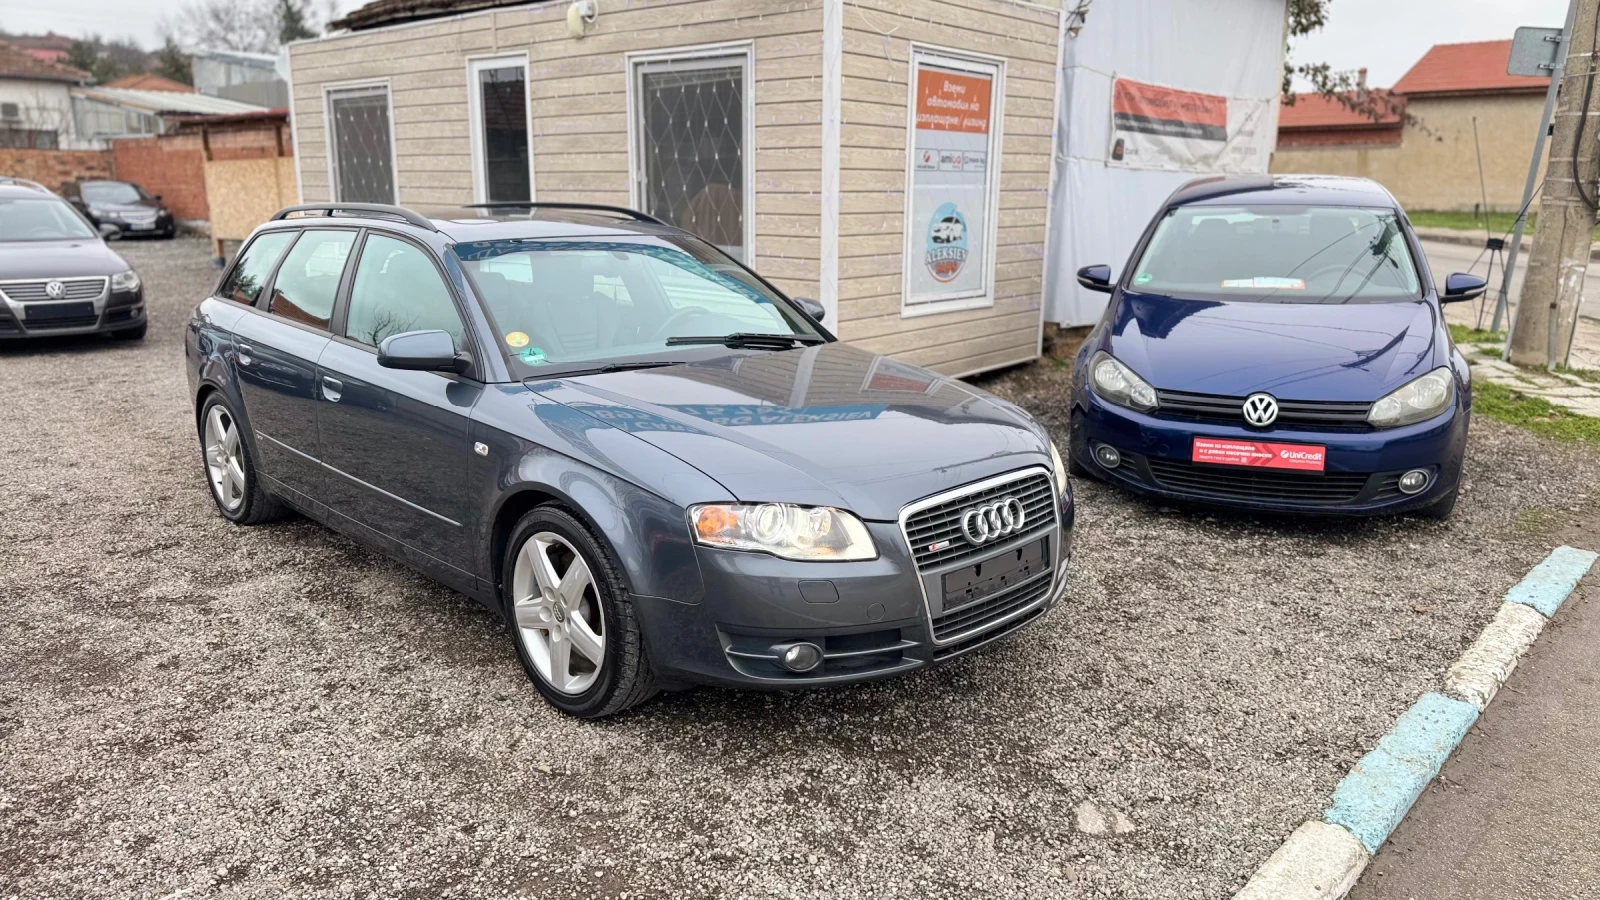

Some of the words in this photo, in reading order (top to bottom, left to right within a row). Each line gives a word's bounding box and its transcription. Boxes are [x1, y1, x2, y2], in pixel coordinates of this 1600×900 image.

[943, 80, 966, 94] Вземи
[926, 95, 969, 110] автомобил
[970, 102, 980, 111] на
[925, 247, 969, 265] ALEKSIEV
[1243, 394, 1279, 427] VW
[1222, 444, 1256, 452] изплащане
[1289, 451, 1323, 461] UniCredit
